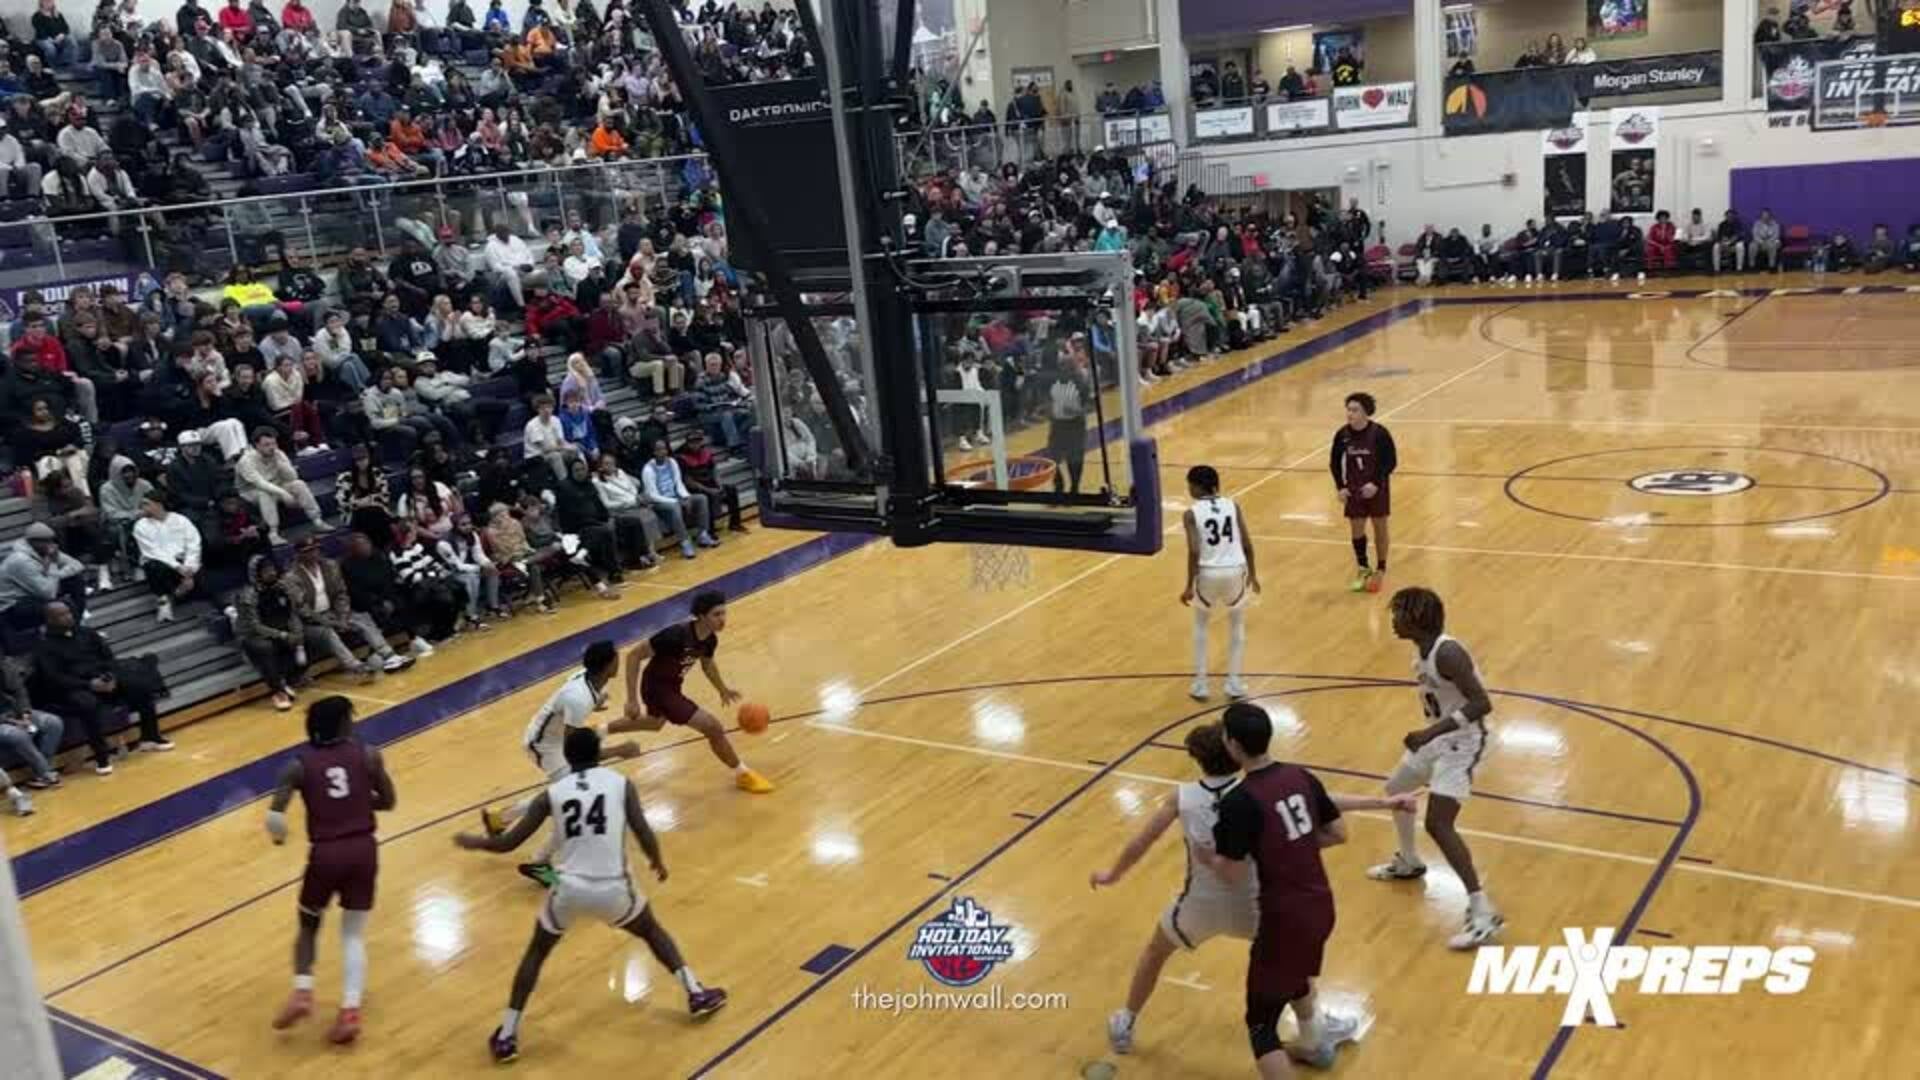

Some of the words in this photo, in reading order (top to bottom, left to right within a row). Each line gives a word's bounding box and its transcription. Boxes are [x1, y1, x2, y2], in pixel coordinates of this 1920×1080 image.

[1593, 73, 1647, 90] Morgan
[1648, 66, 1704, 83] Stanley
[1204, 515, 1233, 546] 34
[325, 766, 350, 799] 3
[562, 793, 607, 839] 24
[1276, 793, 1313, 840] 13
